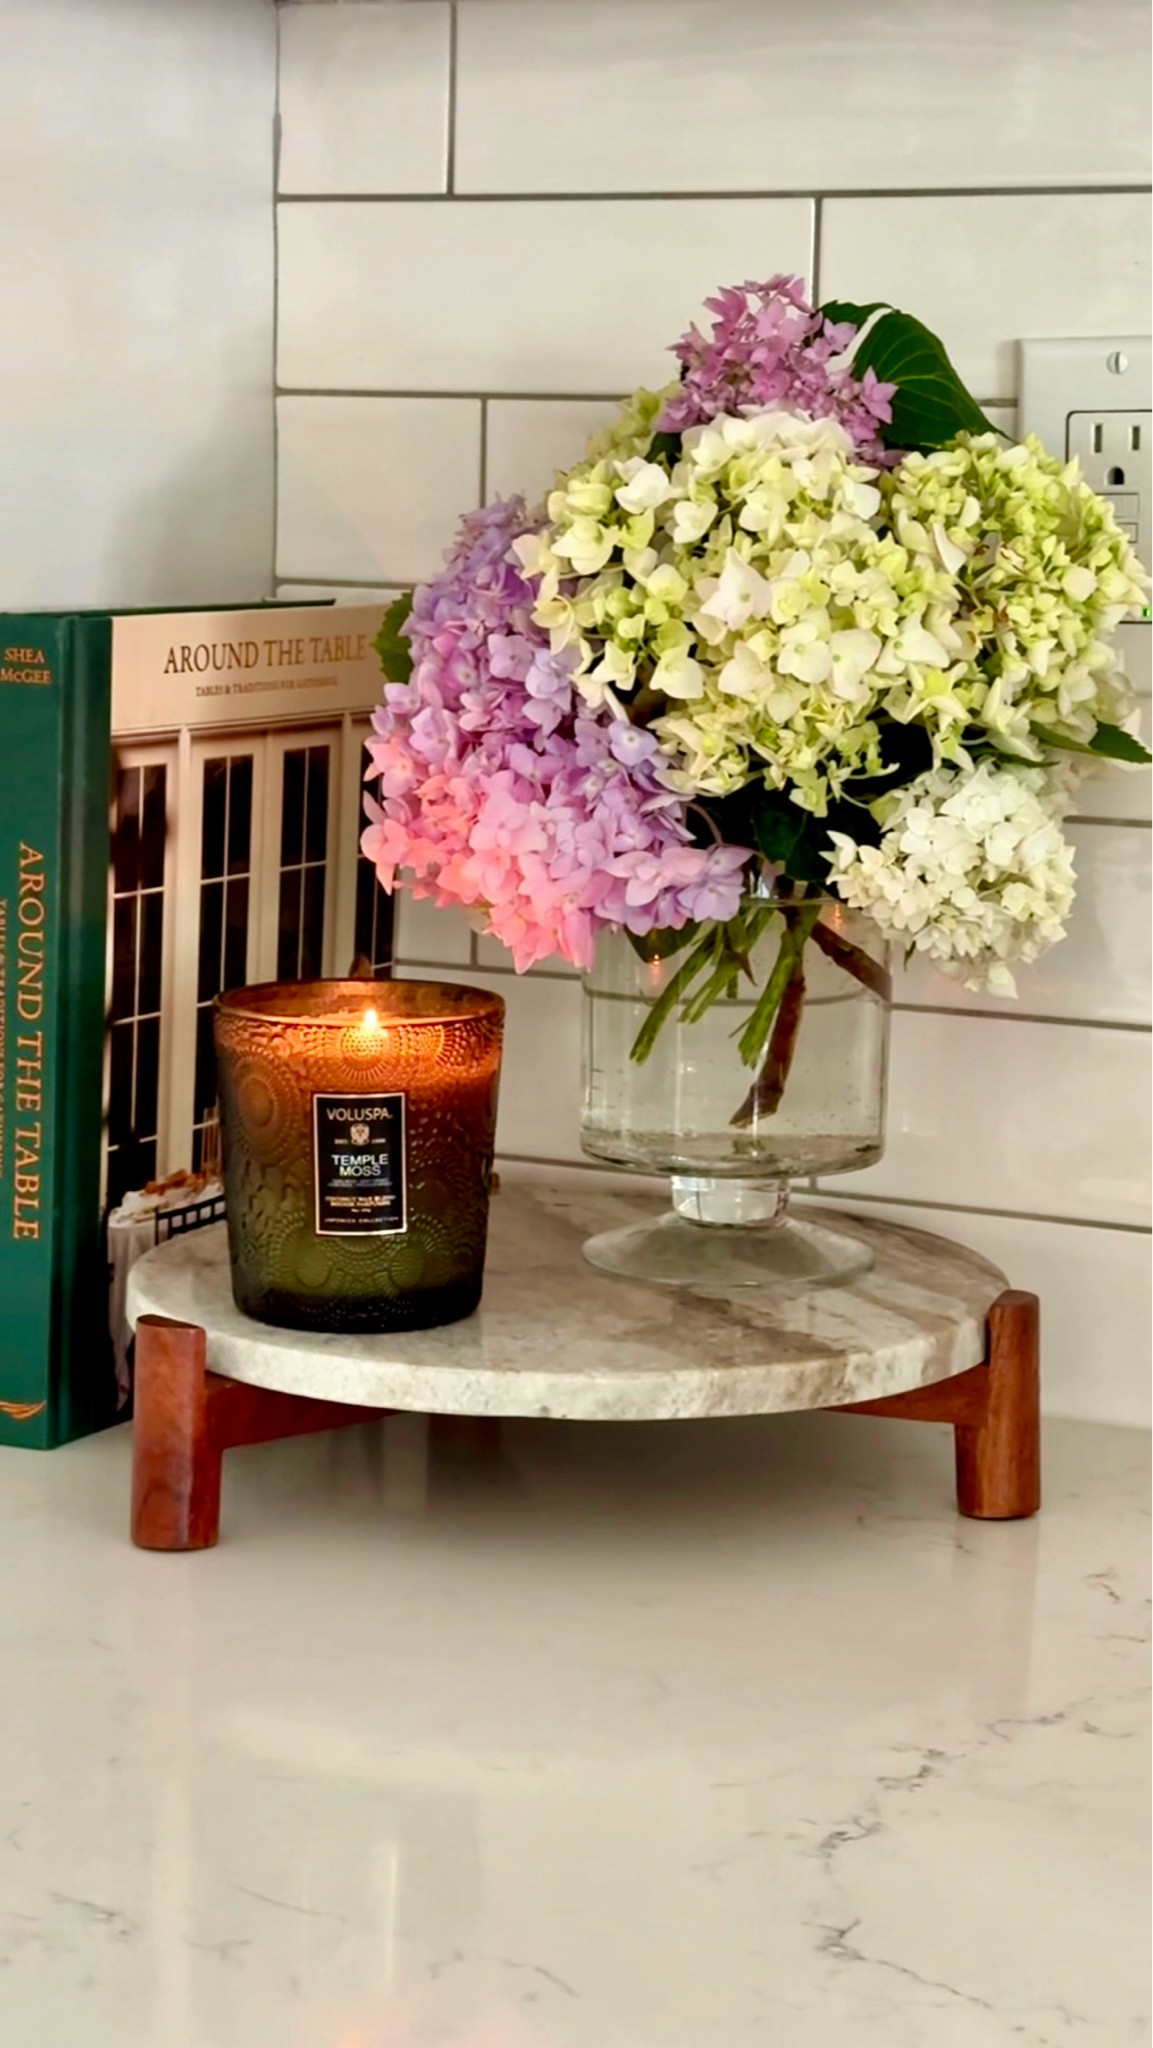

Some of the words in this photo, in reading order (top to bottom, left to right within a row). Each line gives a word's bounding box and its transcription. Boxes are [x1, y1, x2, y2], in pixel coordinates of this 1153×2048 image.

[4, 648, 45, 664] SHEA
[163, 640, 259, 674] AROUND
[263, 639, 304, 667] THE
[310, 635, 367, 664] TABLE
[0, 668, 51, 684] McGEE
[17, 841, 44, 1020] AROUND
[16, 1031, 43, 1112] THE
[327, 1107, 390, 1121] VOLUSPA
[332, 1154, 389, 1166] TEMPLE
[339, 1165, 381, 1177] MOSS
[13, 1122, 41, 1240] TABLE
